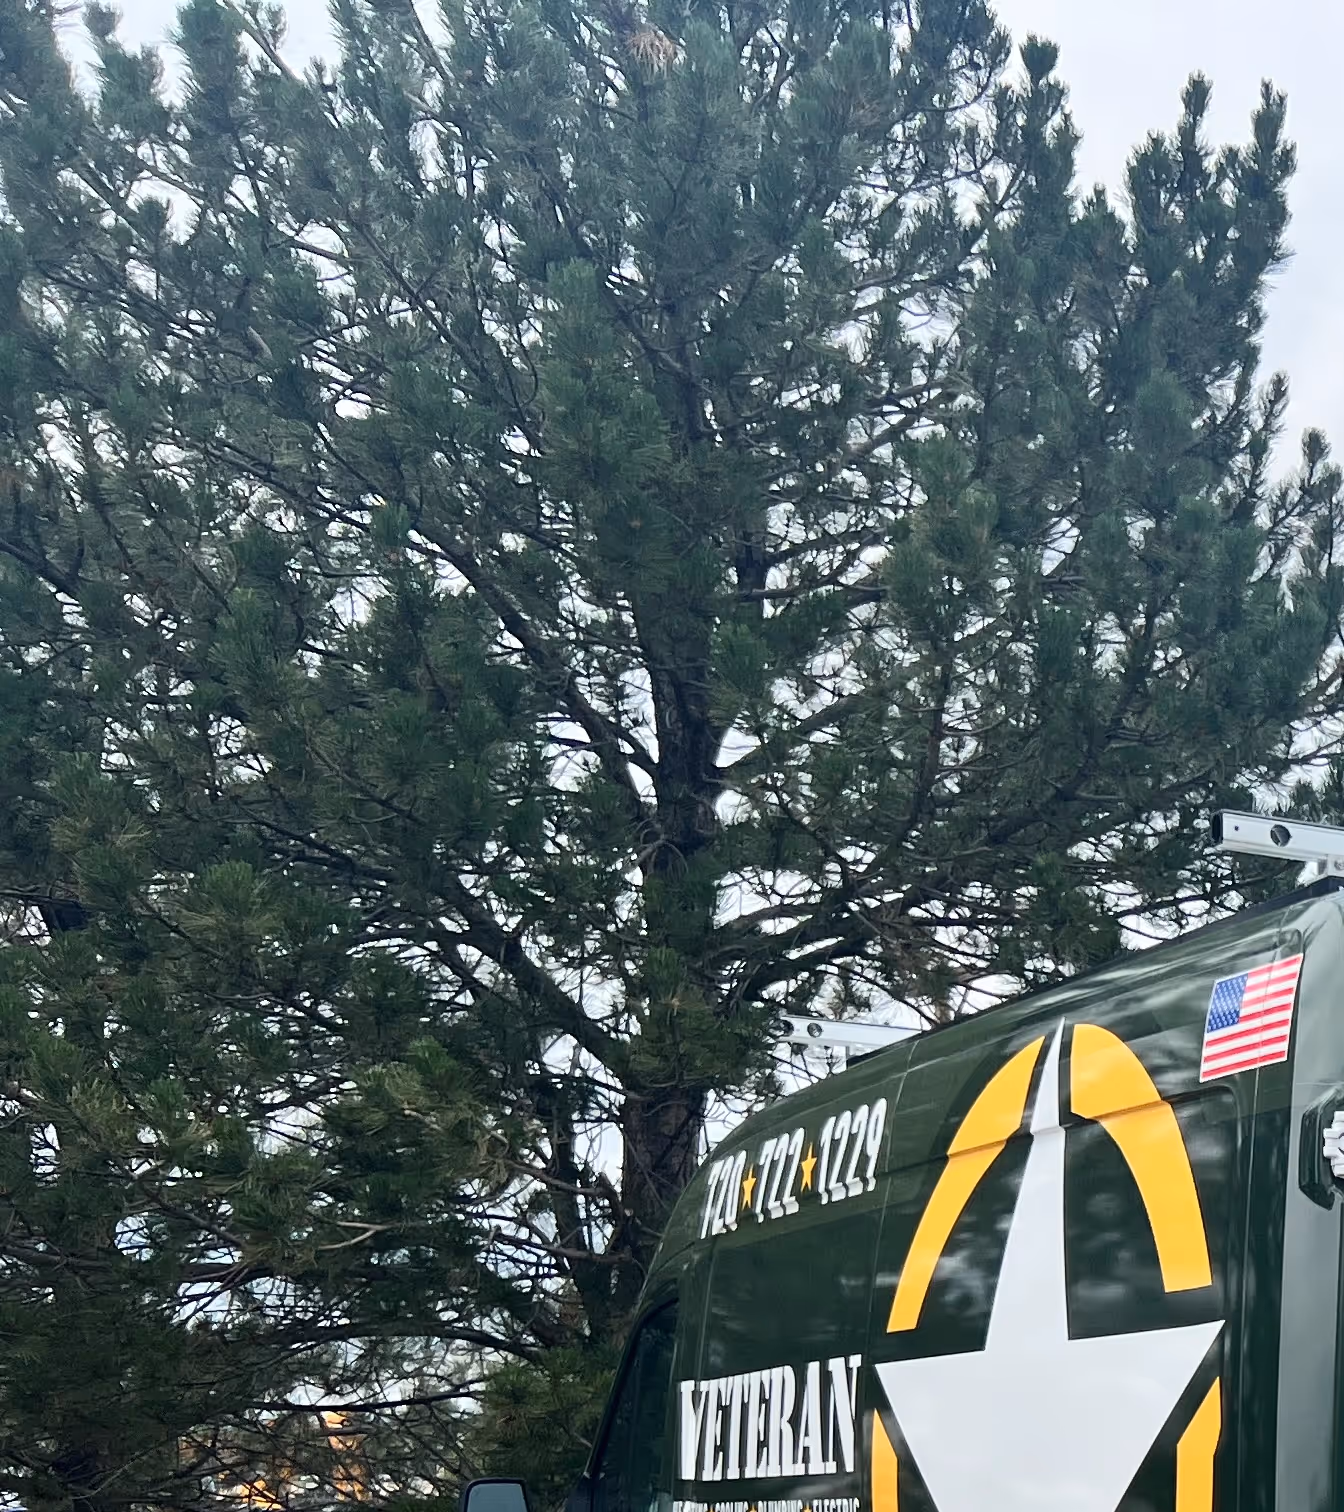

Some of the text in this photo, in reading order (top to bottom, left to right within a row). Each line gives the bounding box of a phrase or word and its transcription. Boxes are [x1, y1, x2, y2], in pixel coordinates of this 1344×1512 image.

[701, 1097, 888, 1240] 720 722 1229
[679, 1354, 863, 1482] VETERAN
